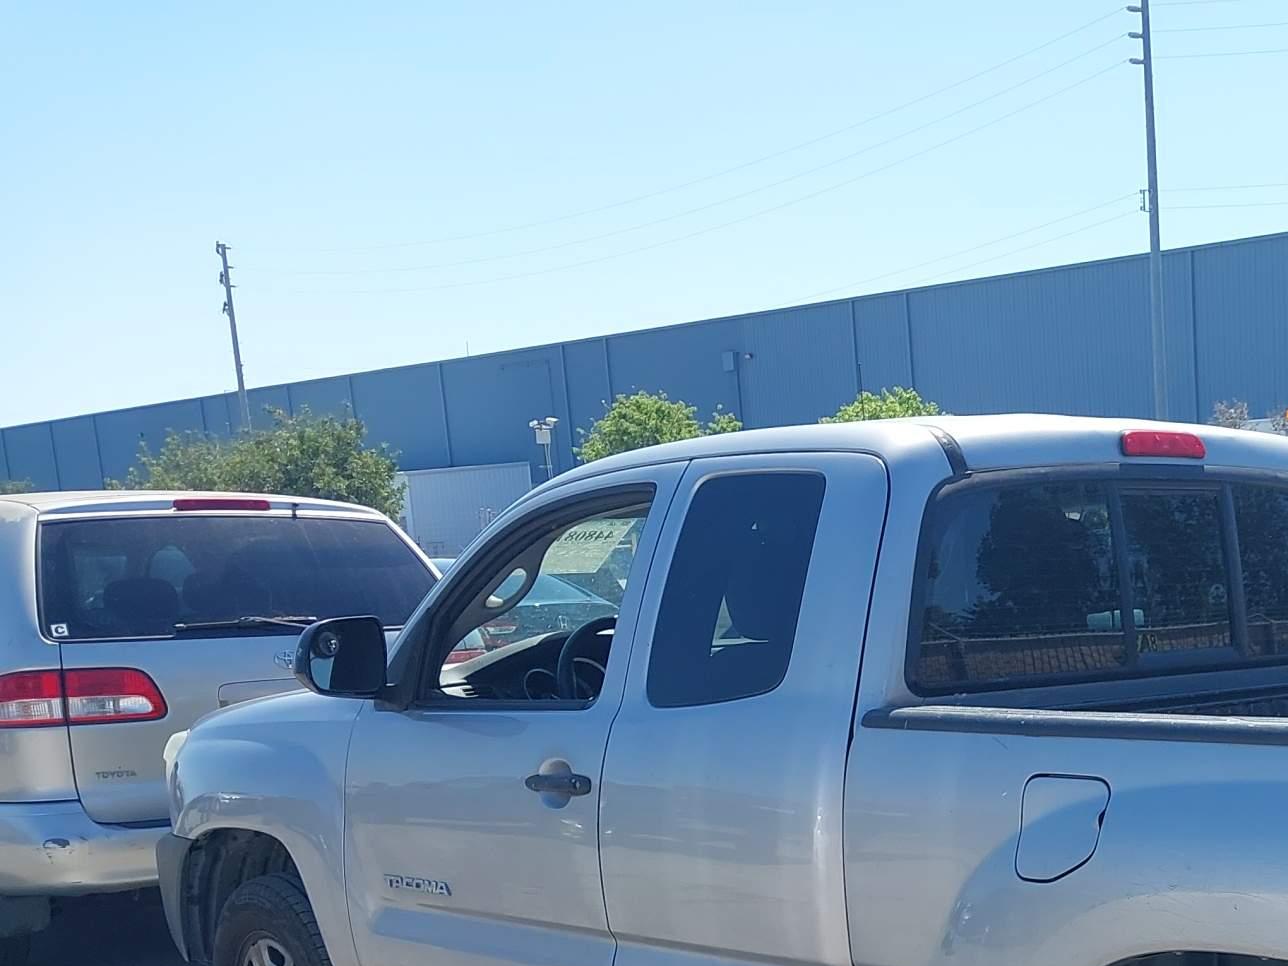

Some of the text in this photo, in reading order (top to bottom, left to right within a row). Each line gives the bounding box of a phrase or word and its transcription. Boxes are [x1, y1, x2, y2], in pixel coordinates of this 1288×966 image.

[54, 625, 66, 635] C
[95, 769, 137, 780] TOYOTA
[384, 874, 452, 897] TACOMA
